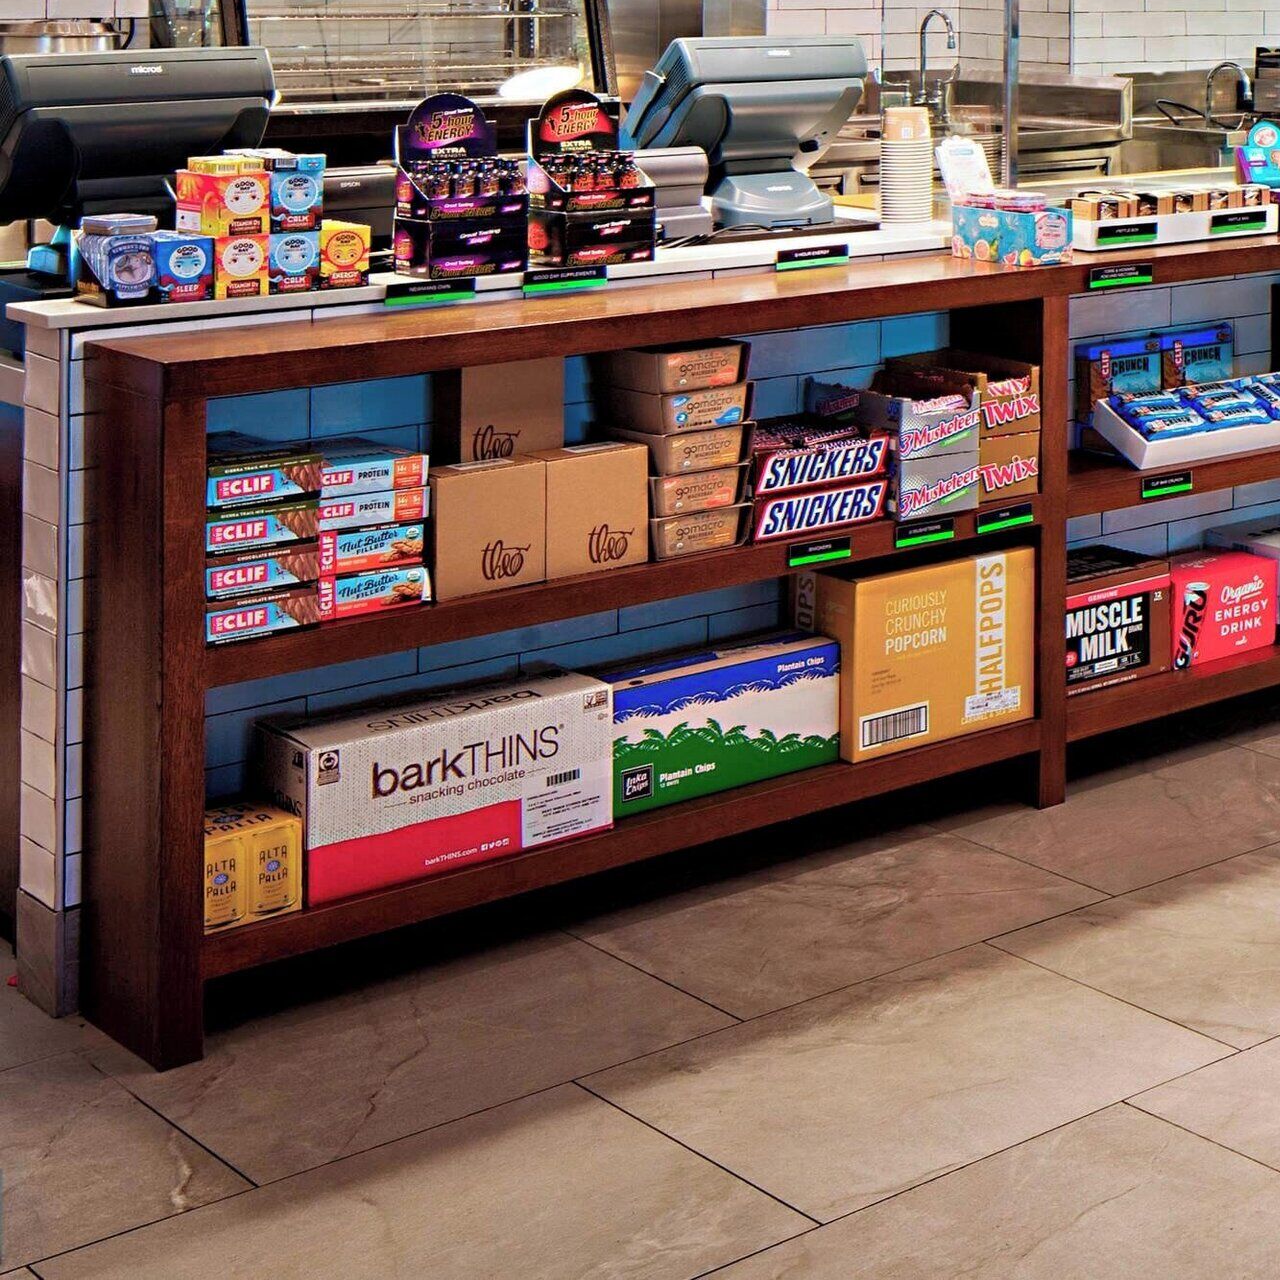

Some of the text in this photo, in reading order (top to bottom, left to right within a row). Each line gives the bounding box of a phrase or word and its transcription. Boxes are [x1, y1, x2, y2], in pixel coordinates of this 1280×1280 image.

[431, 110, 474, 130] 5-hour
[560, 107, 598, 123] 5-hour
[428, 123, 473, 142] ENERGY
[1112, 356, 1149, 376] CRUNCH
[1184, 346, 1221, 366] CRUNCH
[679, 358, 728, 378] gomacro
[687, 395, 732, 414] gomacro
[980, 394, 1040, 429] Twix
[900, 431, 914, 455] 3
[764, 441, 882, 490] SNICKERS
[979, 455, 1038, 492] Twix
[230, 477, 272, 495] CLIF
[322, 469, 389, 485] CLIF PROTEIN
[323, 501, 390, 516] CLIF PROTEIN
[762, 485, 880, 535] SNICKERS
[223, 523, 264, 540] CLIF
[338, 530, 399, 553] Nut Butter
[588, 523, 635, 565] theo
[481, 540, 531, 581] theo
[223, 566, 265, 585] CLIF
[338, 574, 399, 598] Nut Butter
[1088, 590, 1118, 602] GENUINE
[1221, 575, 1265, 603] Organic
[886, 590, 947, 616] CURIOUSLY
[1215, 599, 1268, 622] ENERGY
[223, 610, 265, 629] CLIF
[886, 608, 947, 636] CRUNCHY
[979, 562, 1004, 693] HALFPOPS
[1066, 596, 1143, 639] MUSCLE
[1221, 616, 1262, 636] DRINK
[885, 627, 947, 656] POPCORN
[1081, 627, 1129, 662] MILK
[777, 656, 824, 673] Plantain Chips
[372, 726, 559, 799] barkTHINS
[660, 762, 716, 783] Plantain Chips
[409, 769, 525, 805] snacking chocolate
[626, 772, 647, 788] Inka
[626, 780, 649, 796] Chips
[259, 845, 287, 865] ALTA
[424, 847, 478, 866] barkTHINS.com
[259, 867, 288, 885] PALLA
